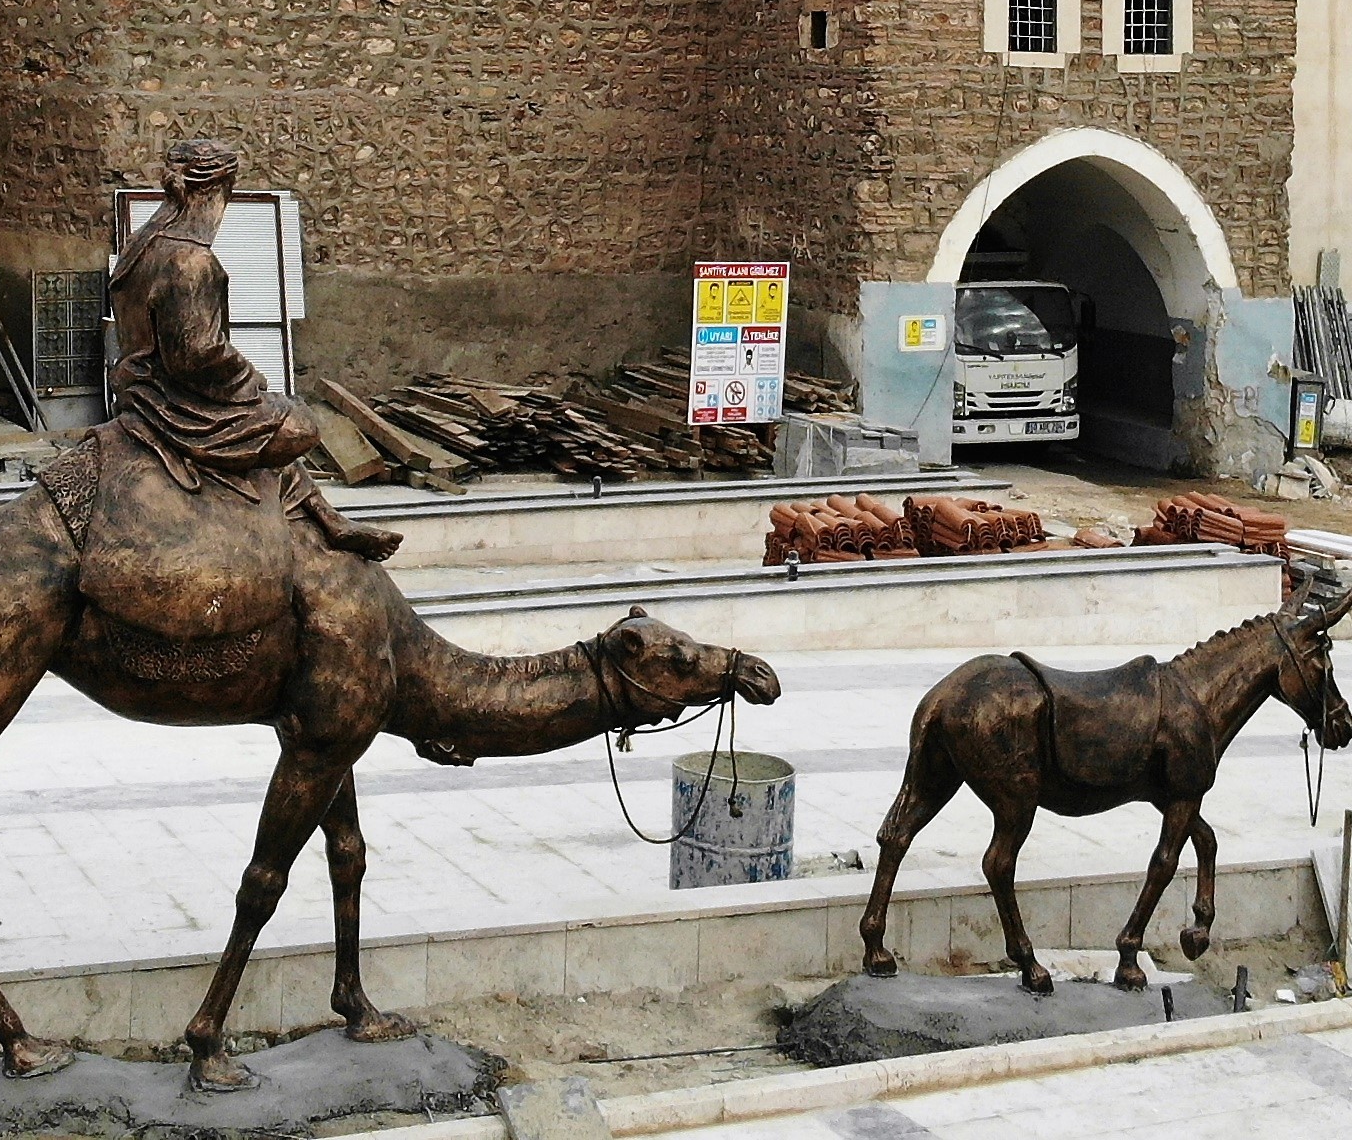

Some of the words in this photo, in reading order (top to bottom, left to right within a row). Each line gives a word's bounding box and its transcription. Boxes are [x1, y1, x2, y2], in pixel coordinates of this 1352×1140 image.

[699, 265, 727, 278] ŞANTİYE
[727, 266, 749, 277] ALANI
[709, 331, 733, 341] UYARI
[750, 329, 779, 341] TEHLİKE
